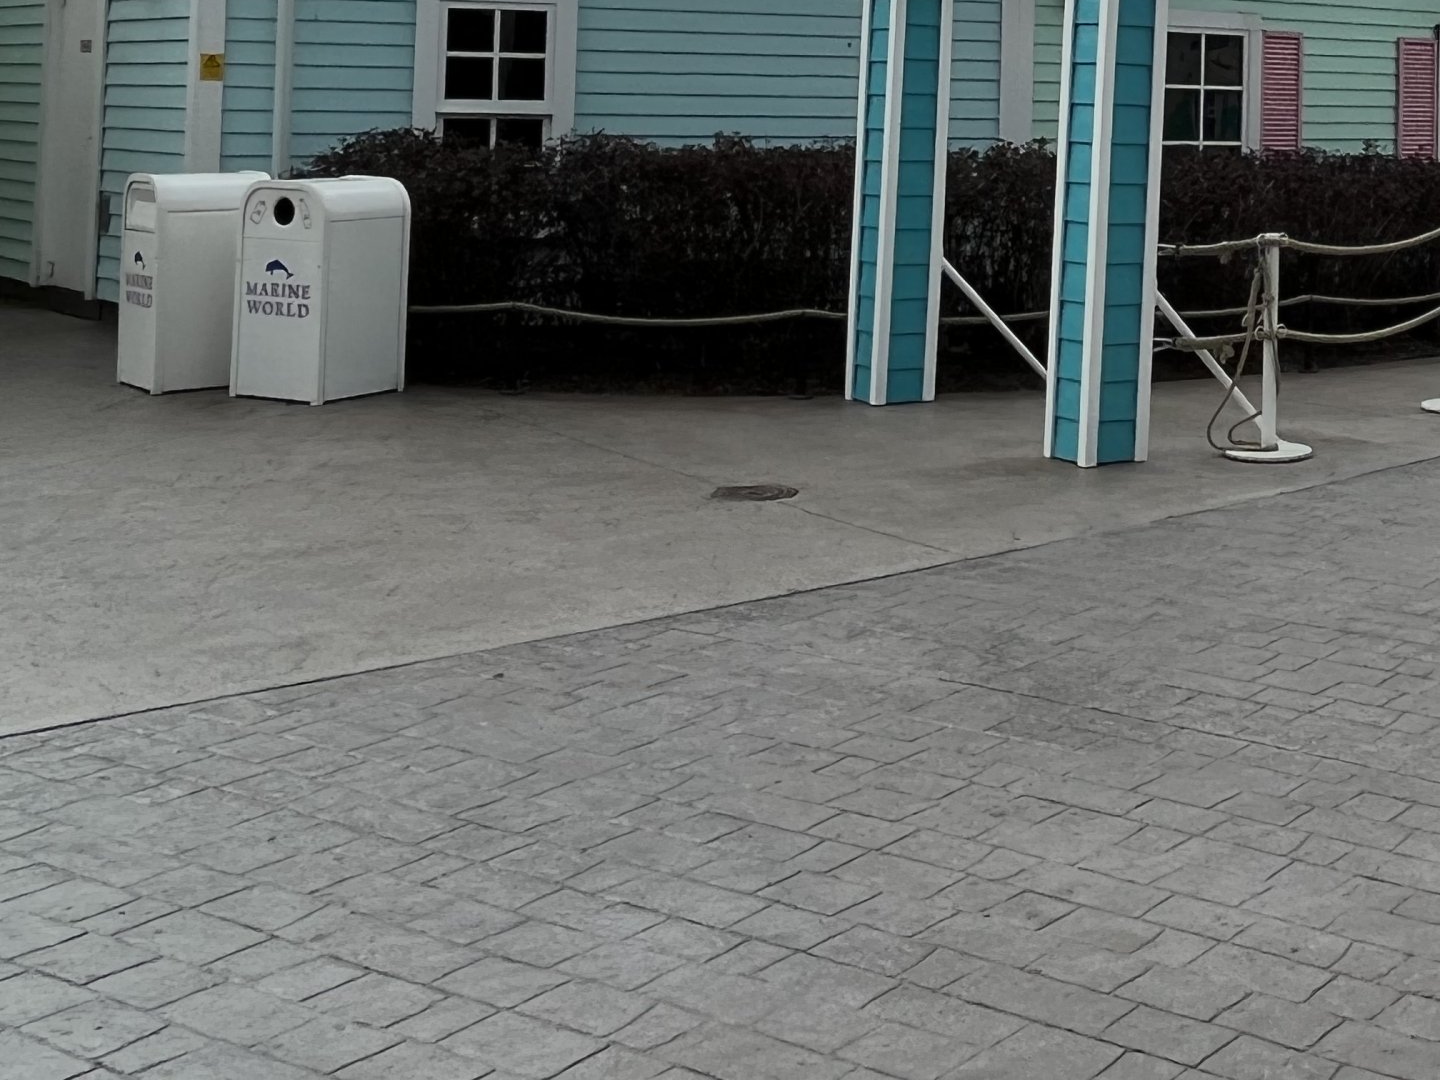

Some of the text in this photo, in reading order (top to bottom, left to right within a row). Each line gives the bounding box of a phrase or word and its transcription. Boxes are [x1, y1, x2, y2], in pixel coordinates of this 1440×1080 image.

[126, 273, 153, 290] MARINE
[245, 281, 311, 300] MARINE
[126, 291, 153, 308] WORLD
[246, 299, 310, 318] WORLD
